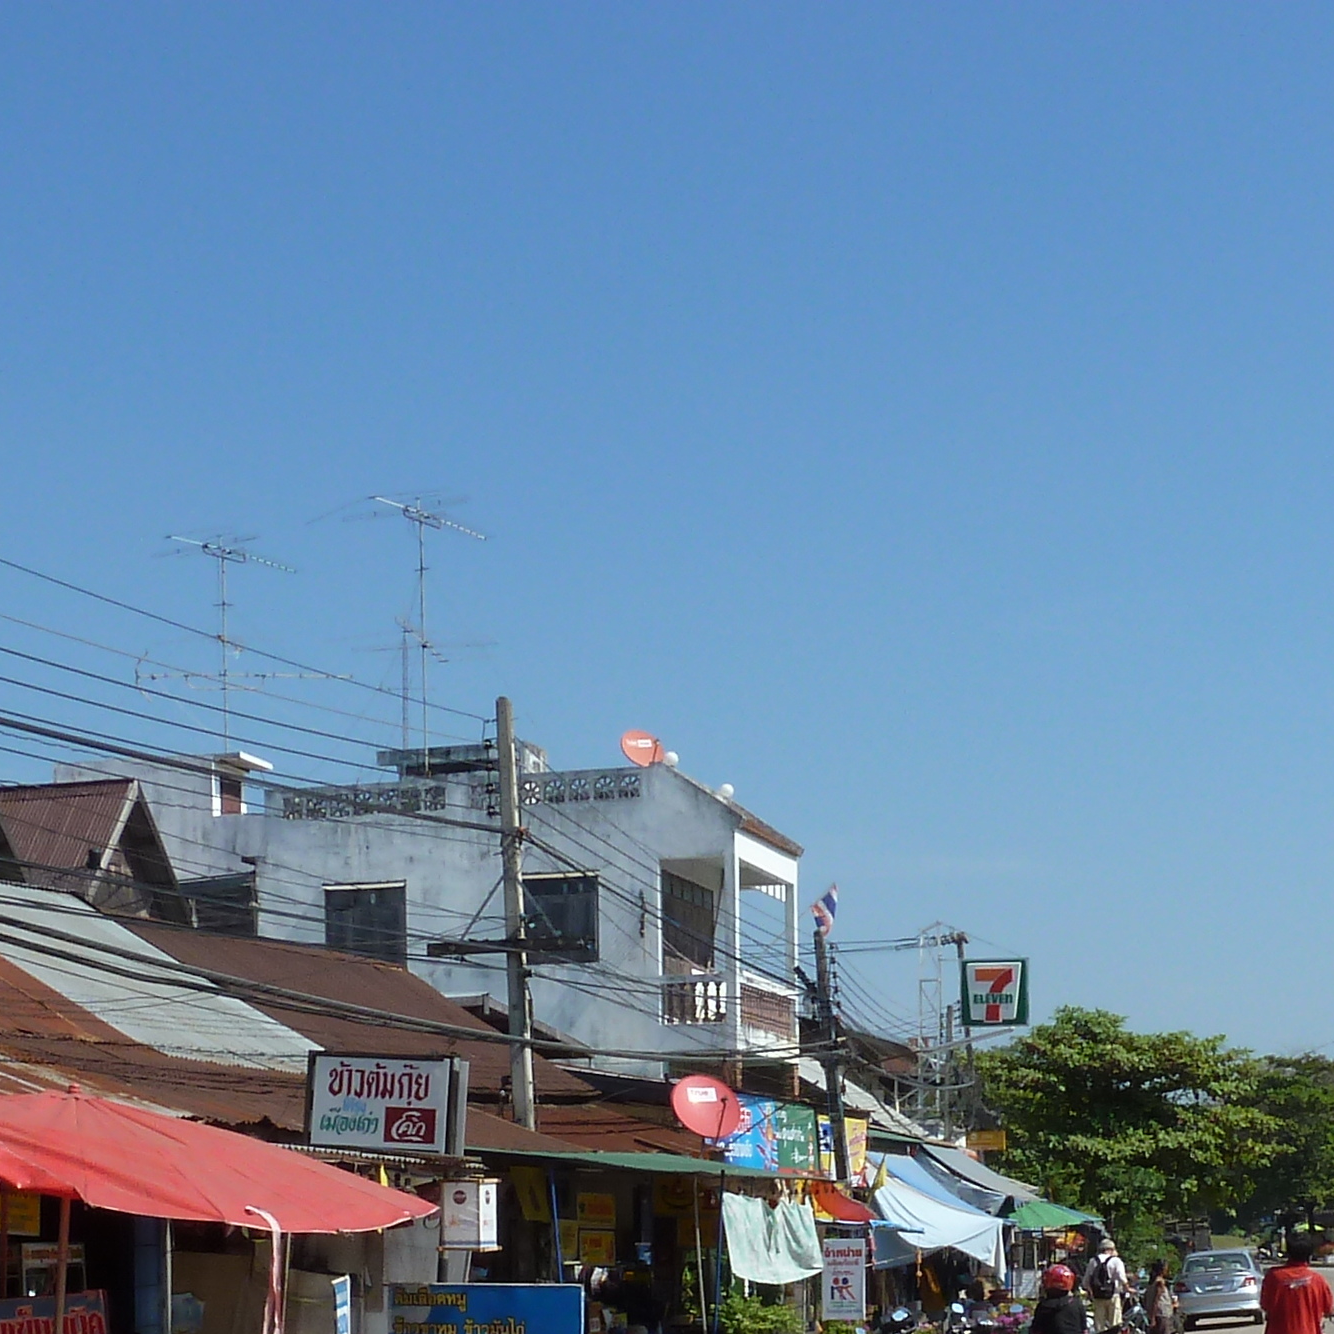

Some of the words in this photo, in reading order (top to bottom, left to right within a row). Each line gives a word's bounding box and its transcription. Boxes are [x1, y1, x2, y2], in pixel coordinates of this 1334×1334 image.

[974, 967, 1014, 1022] 7
[328, 1061, 431, 1106] ข้าวต้มกุ๊ย
[394, 1287, 467, 1313] ต้มเลือดหมู
